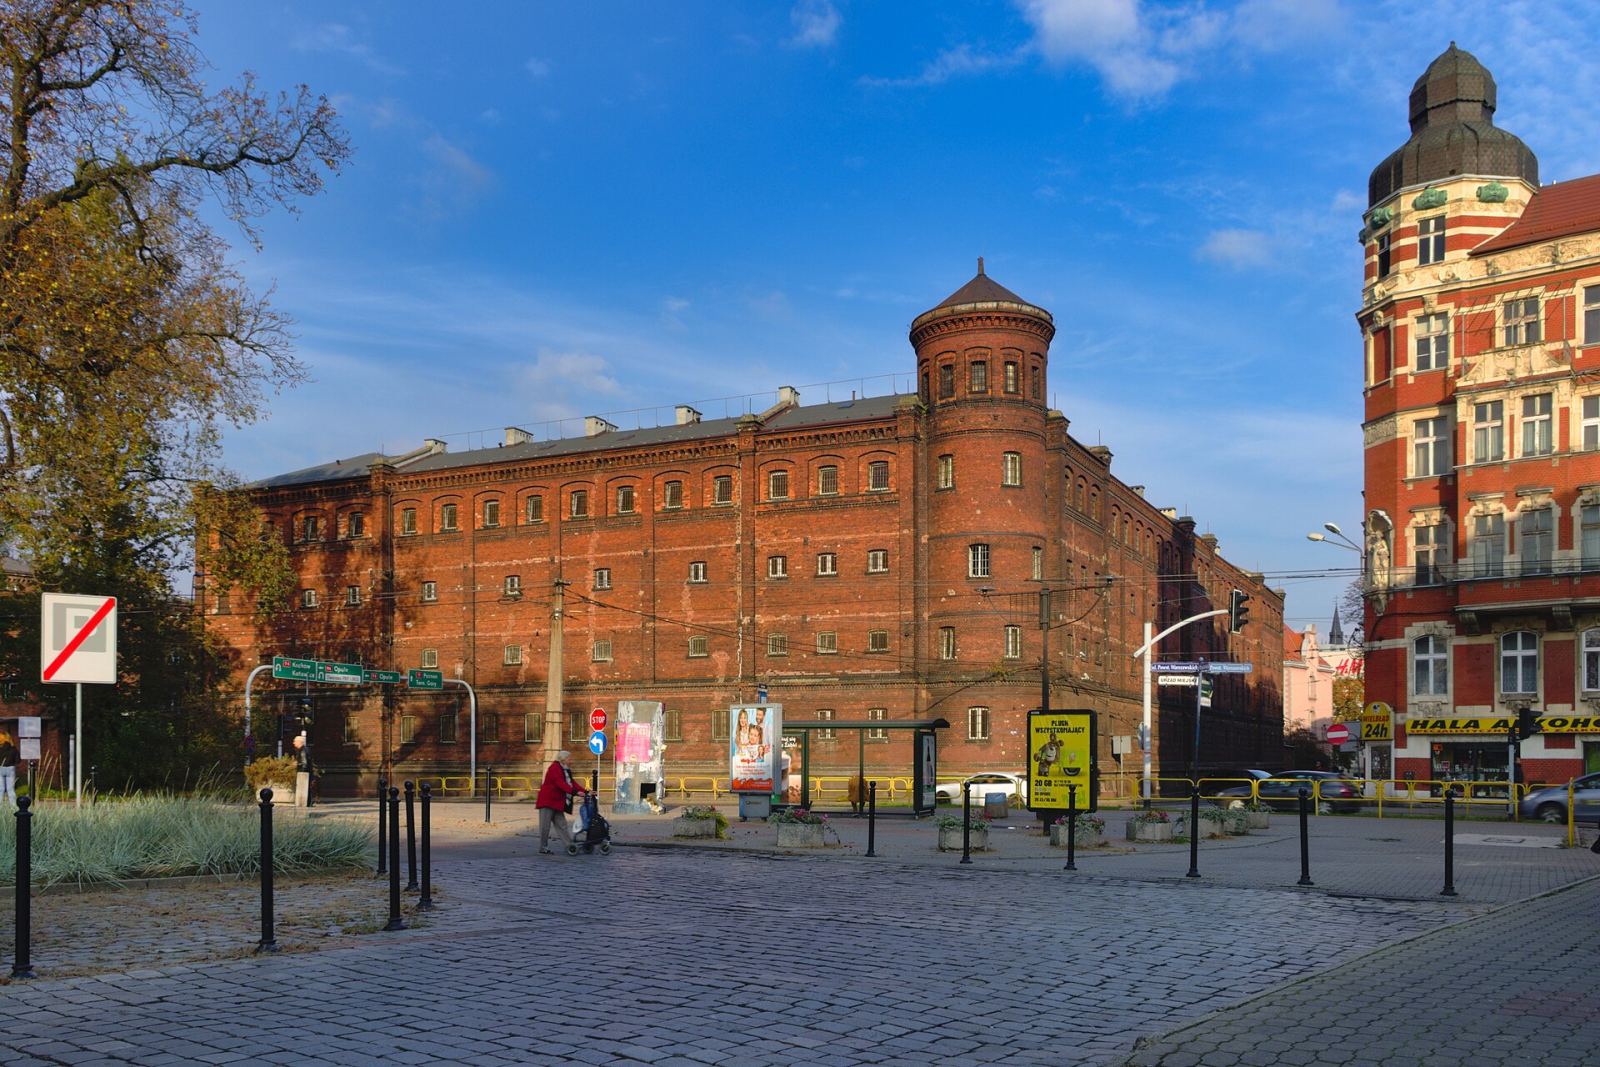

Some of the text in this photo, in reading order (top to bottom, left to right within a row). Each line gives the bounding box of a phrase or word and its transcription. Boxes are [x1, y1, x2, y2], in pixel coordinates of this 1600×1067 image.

[592, 716, 605, 724] STOP
[1411, 720, 1480, 729] HALA
[1364, 723, 1387, 738] 24h
